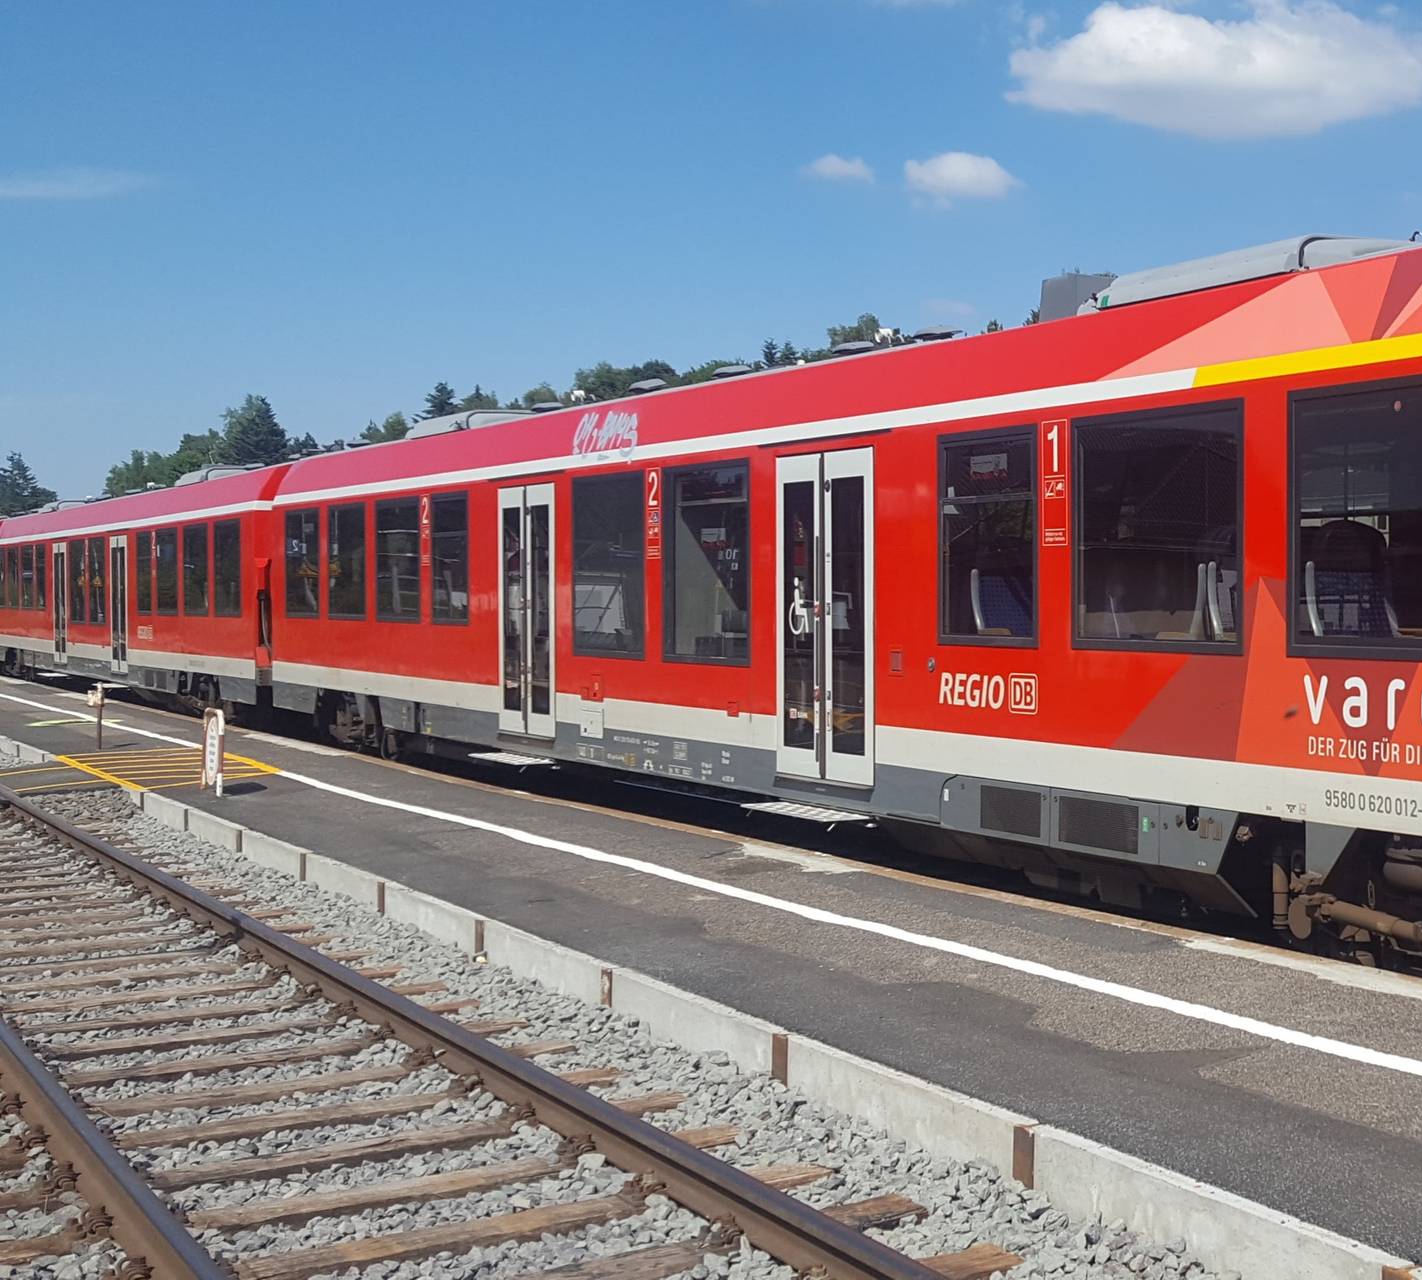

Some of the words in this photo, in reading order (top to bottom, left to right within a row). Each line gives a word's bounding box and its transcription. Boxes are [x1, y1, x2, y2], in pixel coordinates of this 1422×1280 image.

[1047, 425, 1059, 472] 1
[648, 471, 658, 506] 2
[422, 497, 429, 524] 2
[939, 672, 1005, 709] REGIO
[1012, 677, 1035, 709] DB
[1308, 736, 1334, 758] DER
[1339, 738, 1367, 760] ZUG
[1372, 738, 1400, 763] FÜR
[1325, 789, 1355, 810] 9580
[1359, 794, 1366, 811] 0
[1368, 795, 1392, 814] 620
